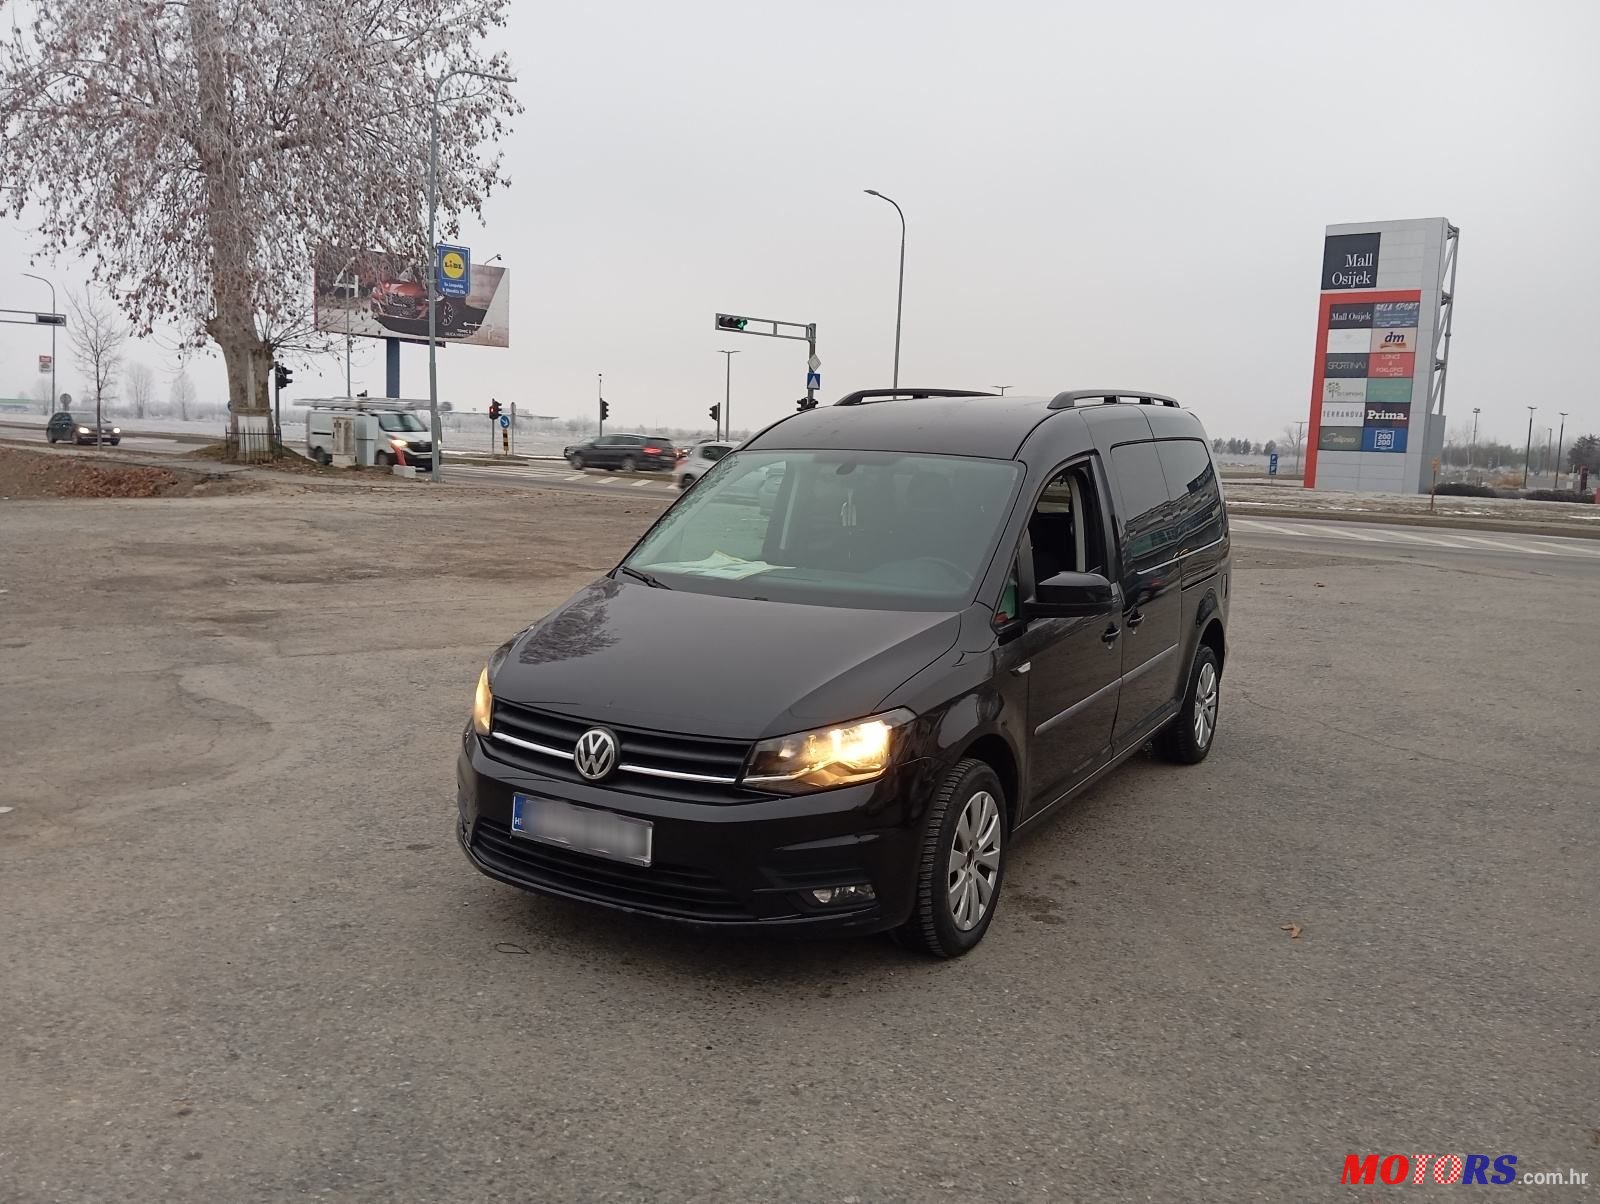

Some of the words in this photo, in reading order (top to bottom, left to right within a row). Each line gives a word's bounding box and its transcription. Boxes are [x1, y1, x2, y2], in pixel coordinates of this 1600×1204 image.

[1345, 253, 1373, 268] Mall
[1331, 271, 1372, 288] Osijek
[1332, 312, 1348, 321] Mall
[1348, 311, 1372, 322] Osijek
[1384, 331, 1405, 343] dm
